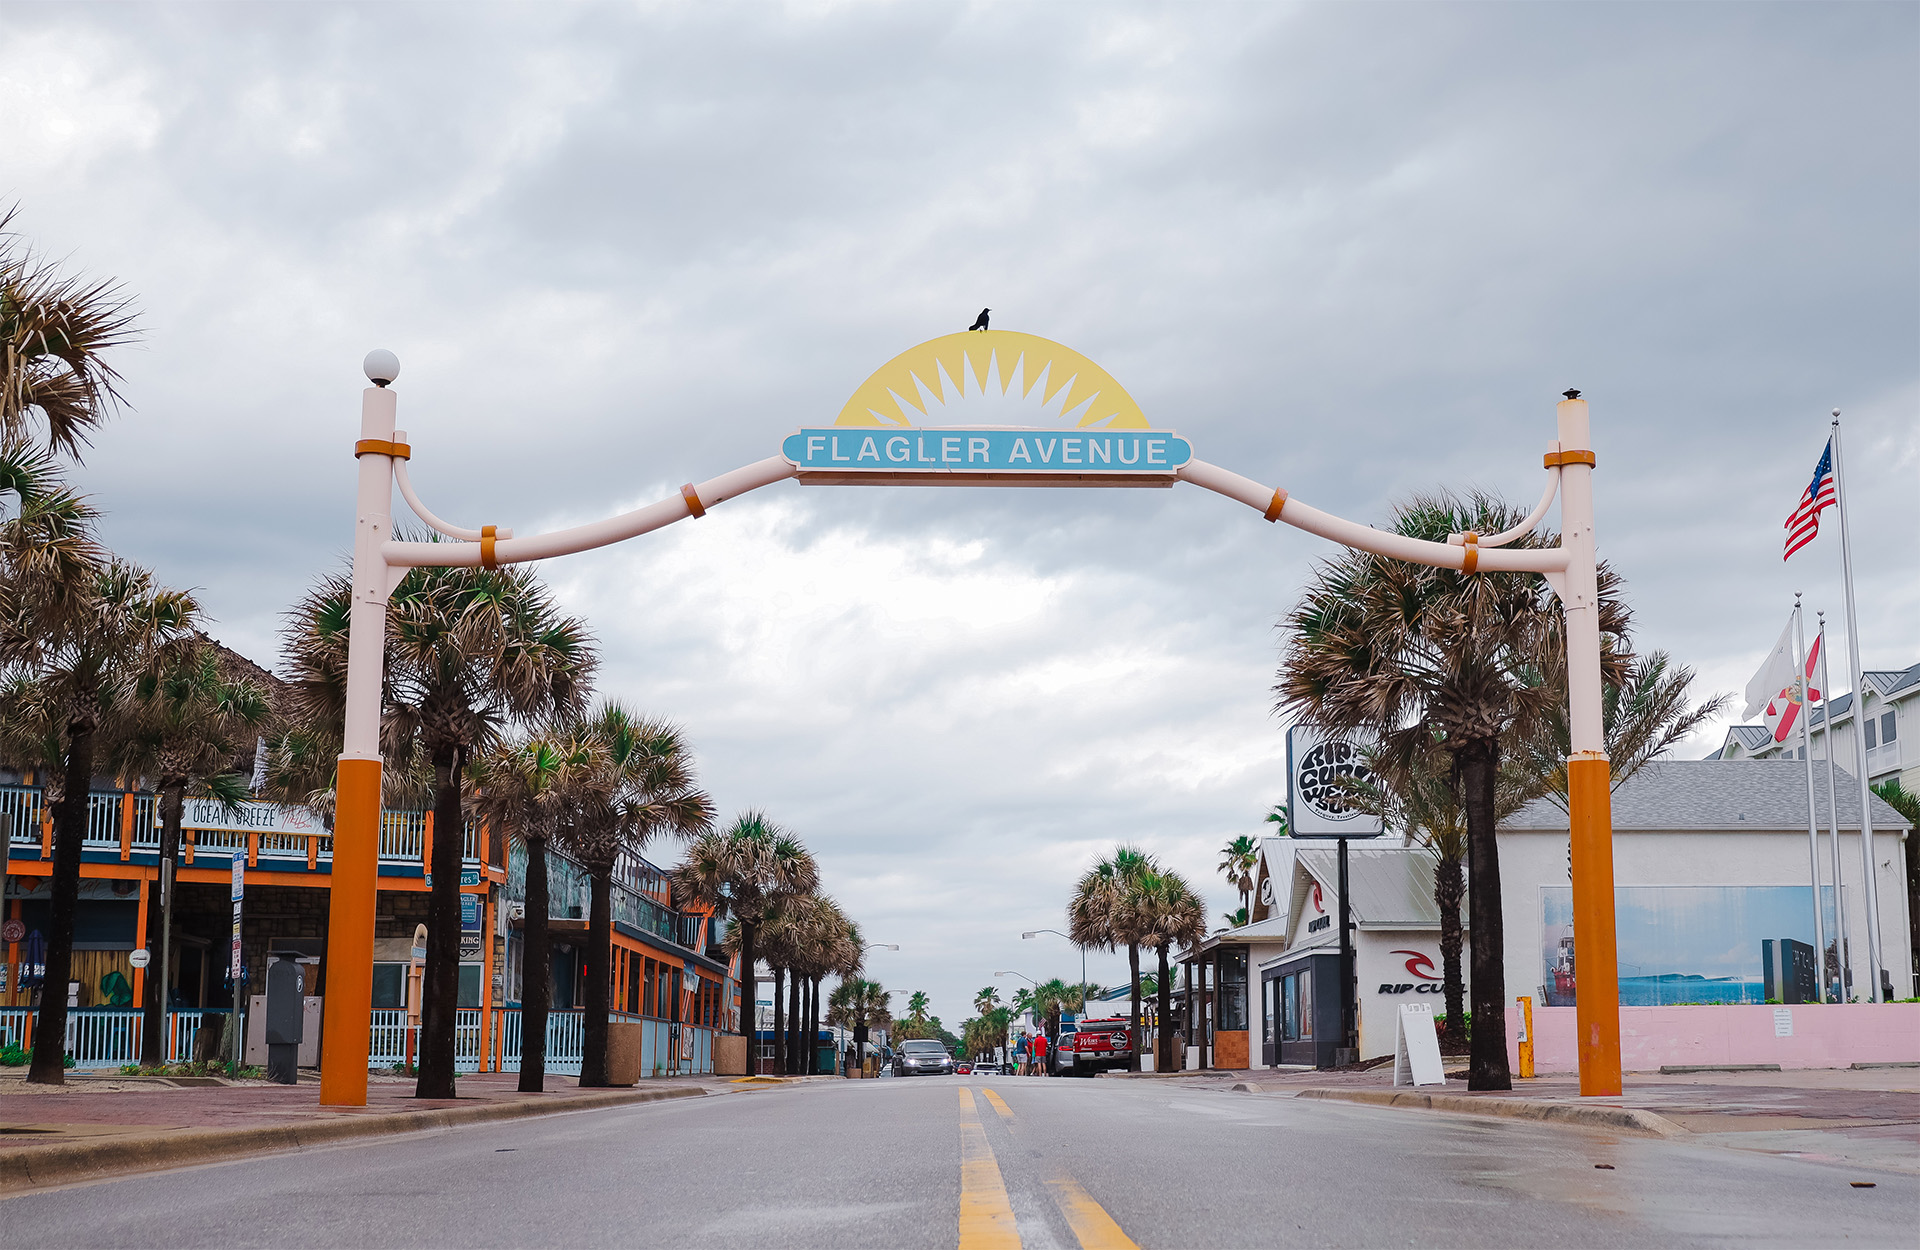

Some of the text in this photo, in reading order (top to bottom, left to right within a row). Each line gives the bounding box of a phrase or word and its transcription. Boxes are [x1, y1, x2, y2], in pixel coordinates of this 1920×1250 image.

[807, 436, 1167, 464] FLAGLER AVENUE
[1301, 741, 1352, 770] RIP
[193, 805, 228, 825] OCEAN
[236, 807, 276, 828] BREEZE
[460, 936, 479, 945] KING
[1378, 983, 1468, 994] RIP CUL
